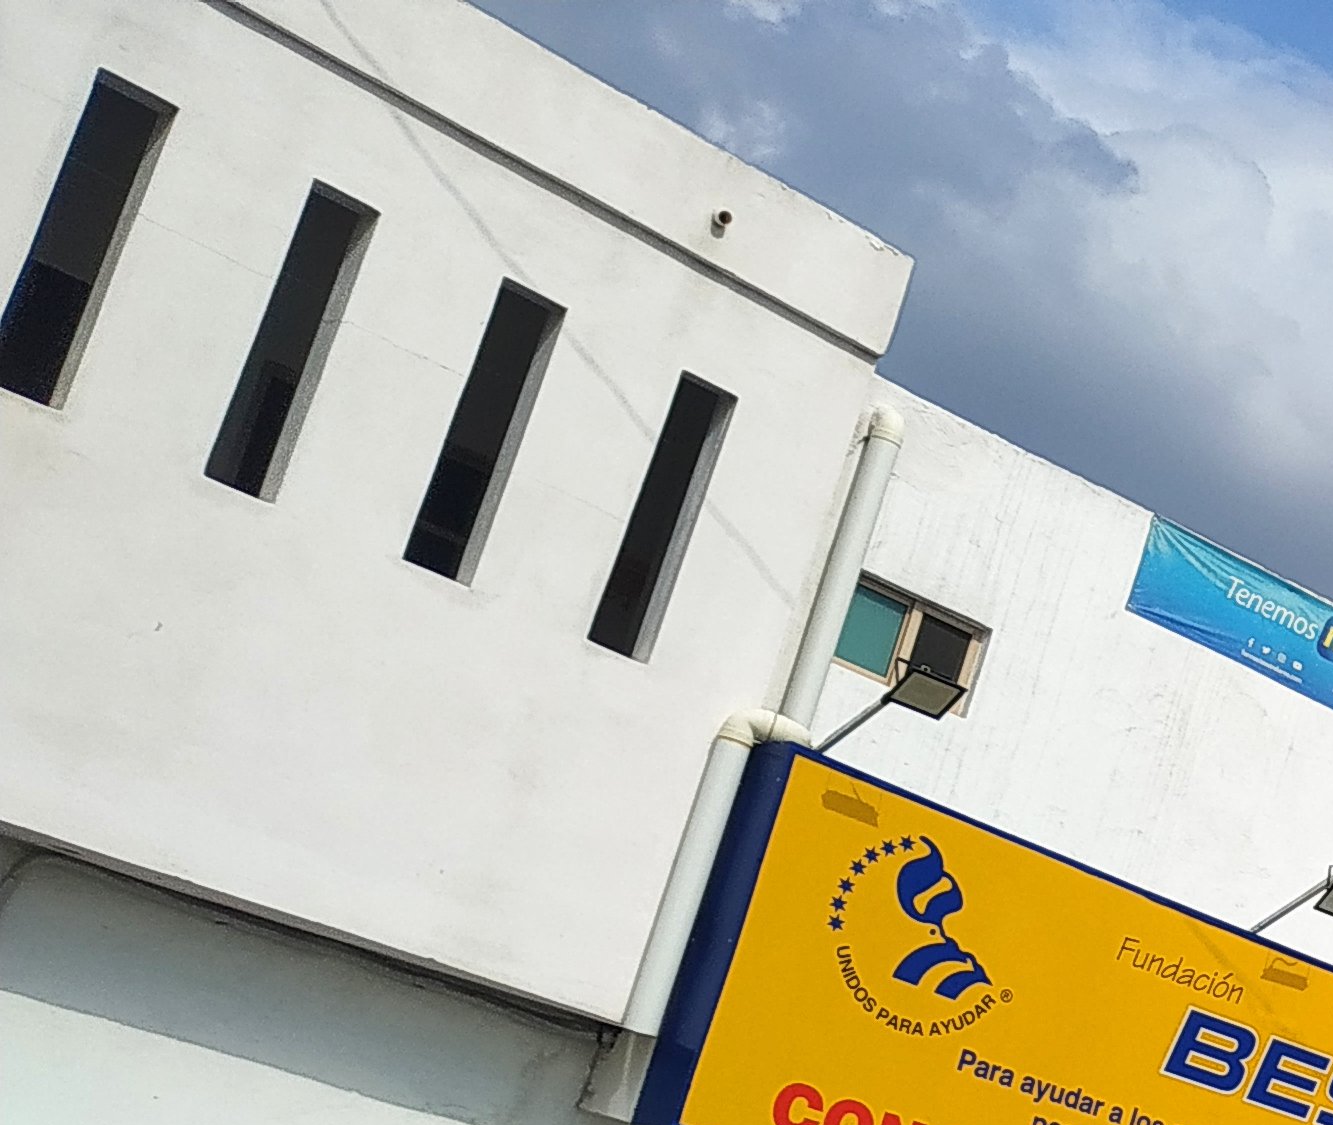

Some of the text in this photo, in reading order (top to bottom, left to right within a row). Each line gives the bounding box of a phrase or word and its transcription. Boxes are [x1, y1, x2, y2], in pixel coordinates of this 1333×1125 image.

[1225, 577, 1320, 641] Tenemos
[836, 945, 997, 1037] UNIDOS PARA AYUDAR
[1116, 937, 1245, 1005] Fundación
[956, 1049, 1015, 1088] Para
[1020, 1074, 1105, 1118] ayudar
[1108, 1104, 1123, 1124] a
